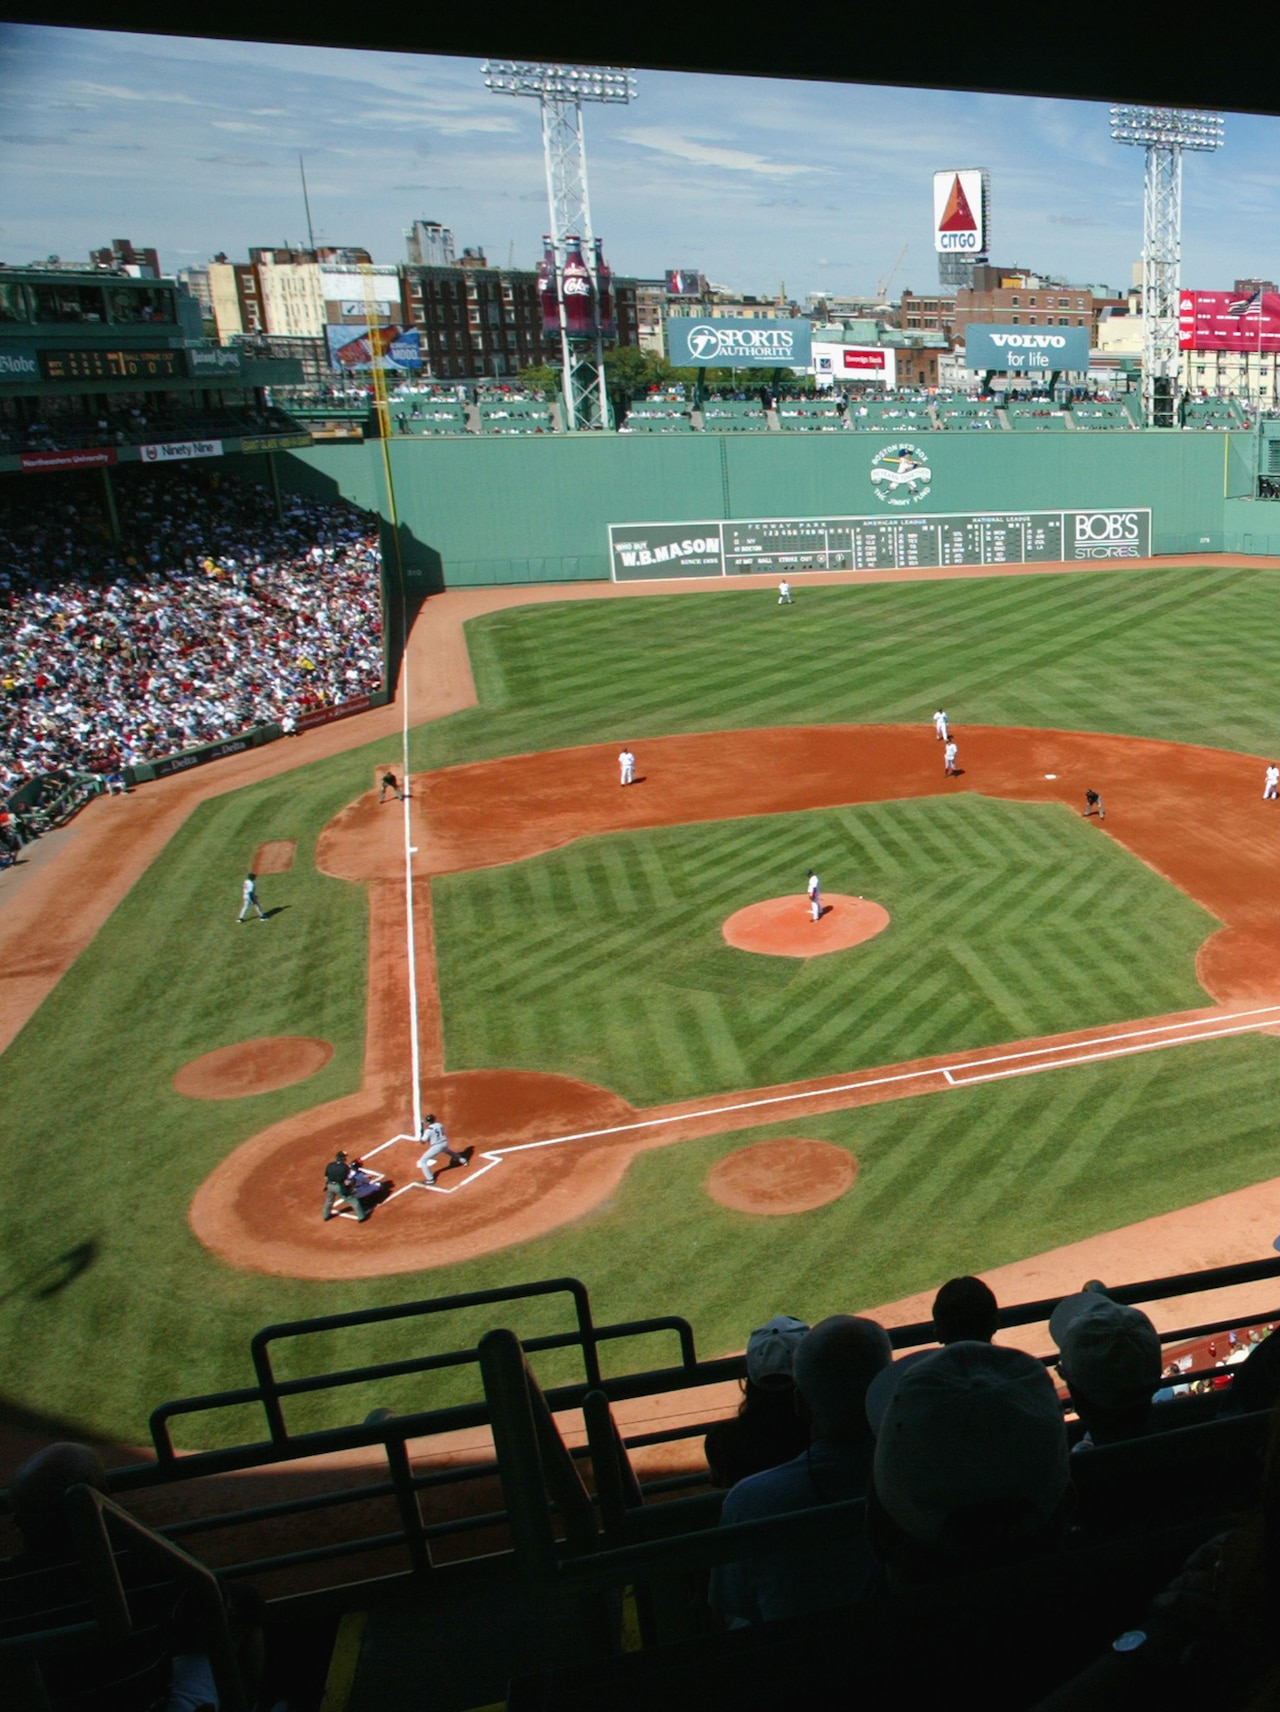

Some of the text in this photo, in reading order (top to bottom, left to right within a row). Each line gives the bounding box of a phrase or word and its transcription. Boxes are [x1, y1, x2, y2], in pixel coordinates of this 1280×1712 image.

[941, 233, 976, 248] CITGO
[564, 277, 590, 296] Coke
[720, 331, 793, 348] SPORTS
[989, 334, 1066, 347] VOLVO
[718, 347, 792, 357] AUTHORITY
[1007, 352, 1049, 367] for life
[162, 443, 214, 456] Ninety Nine
[871, 443, 929, 466] BOSTON RED SOX
[23, 454, 109, 467] Northeastern University
[874, 486, 931, 506] THE JIMMY FUND
[1075, 513, 1139, 541] BOB'S
[222, 741, 246, 754] Delta
[171, 756, 197, 770] Delta
